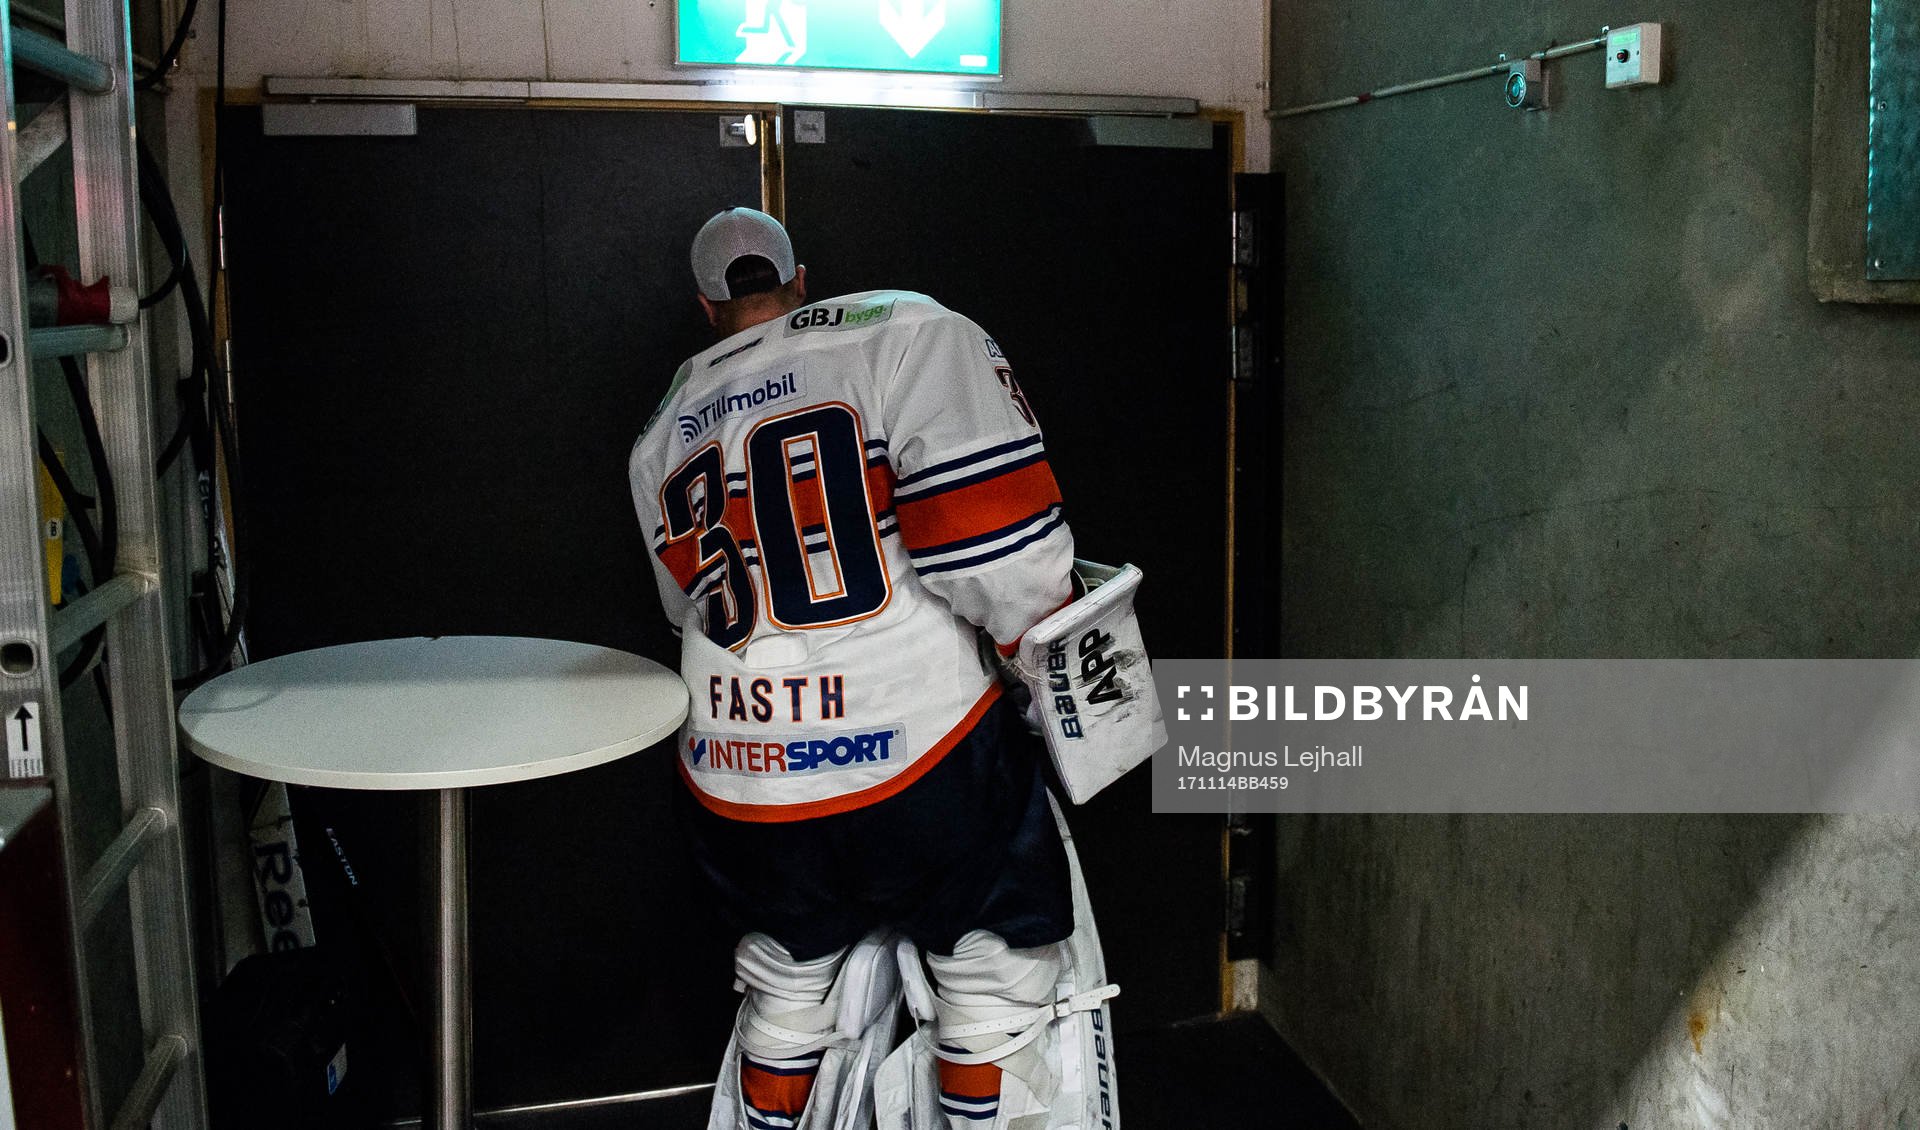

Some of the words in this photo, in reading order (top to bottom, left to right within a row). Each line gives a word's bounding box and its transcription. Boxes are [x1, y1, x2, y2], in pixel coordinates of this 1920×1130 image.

[790, 307, 844, 330] GBJ
[698, 371, 797, 428] Tillmobil
[658, 400, 893, 653] 30
[1078, 628, 1124, 706] APP
[709, 674, 845, 723] FASTH
[708, 729, 895, 773] INTERSPORT
